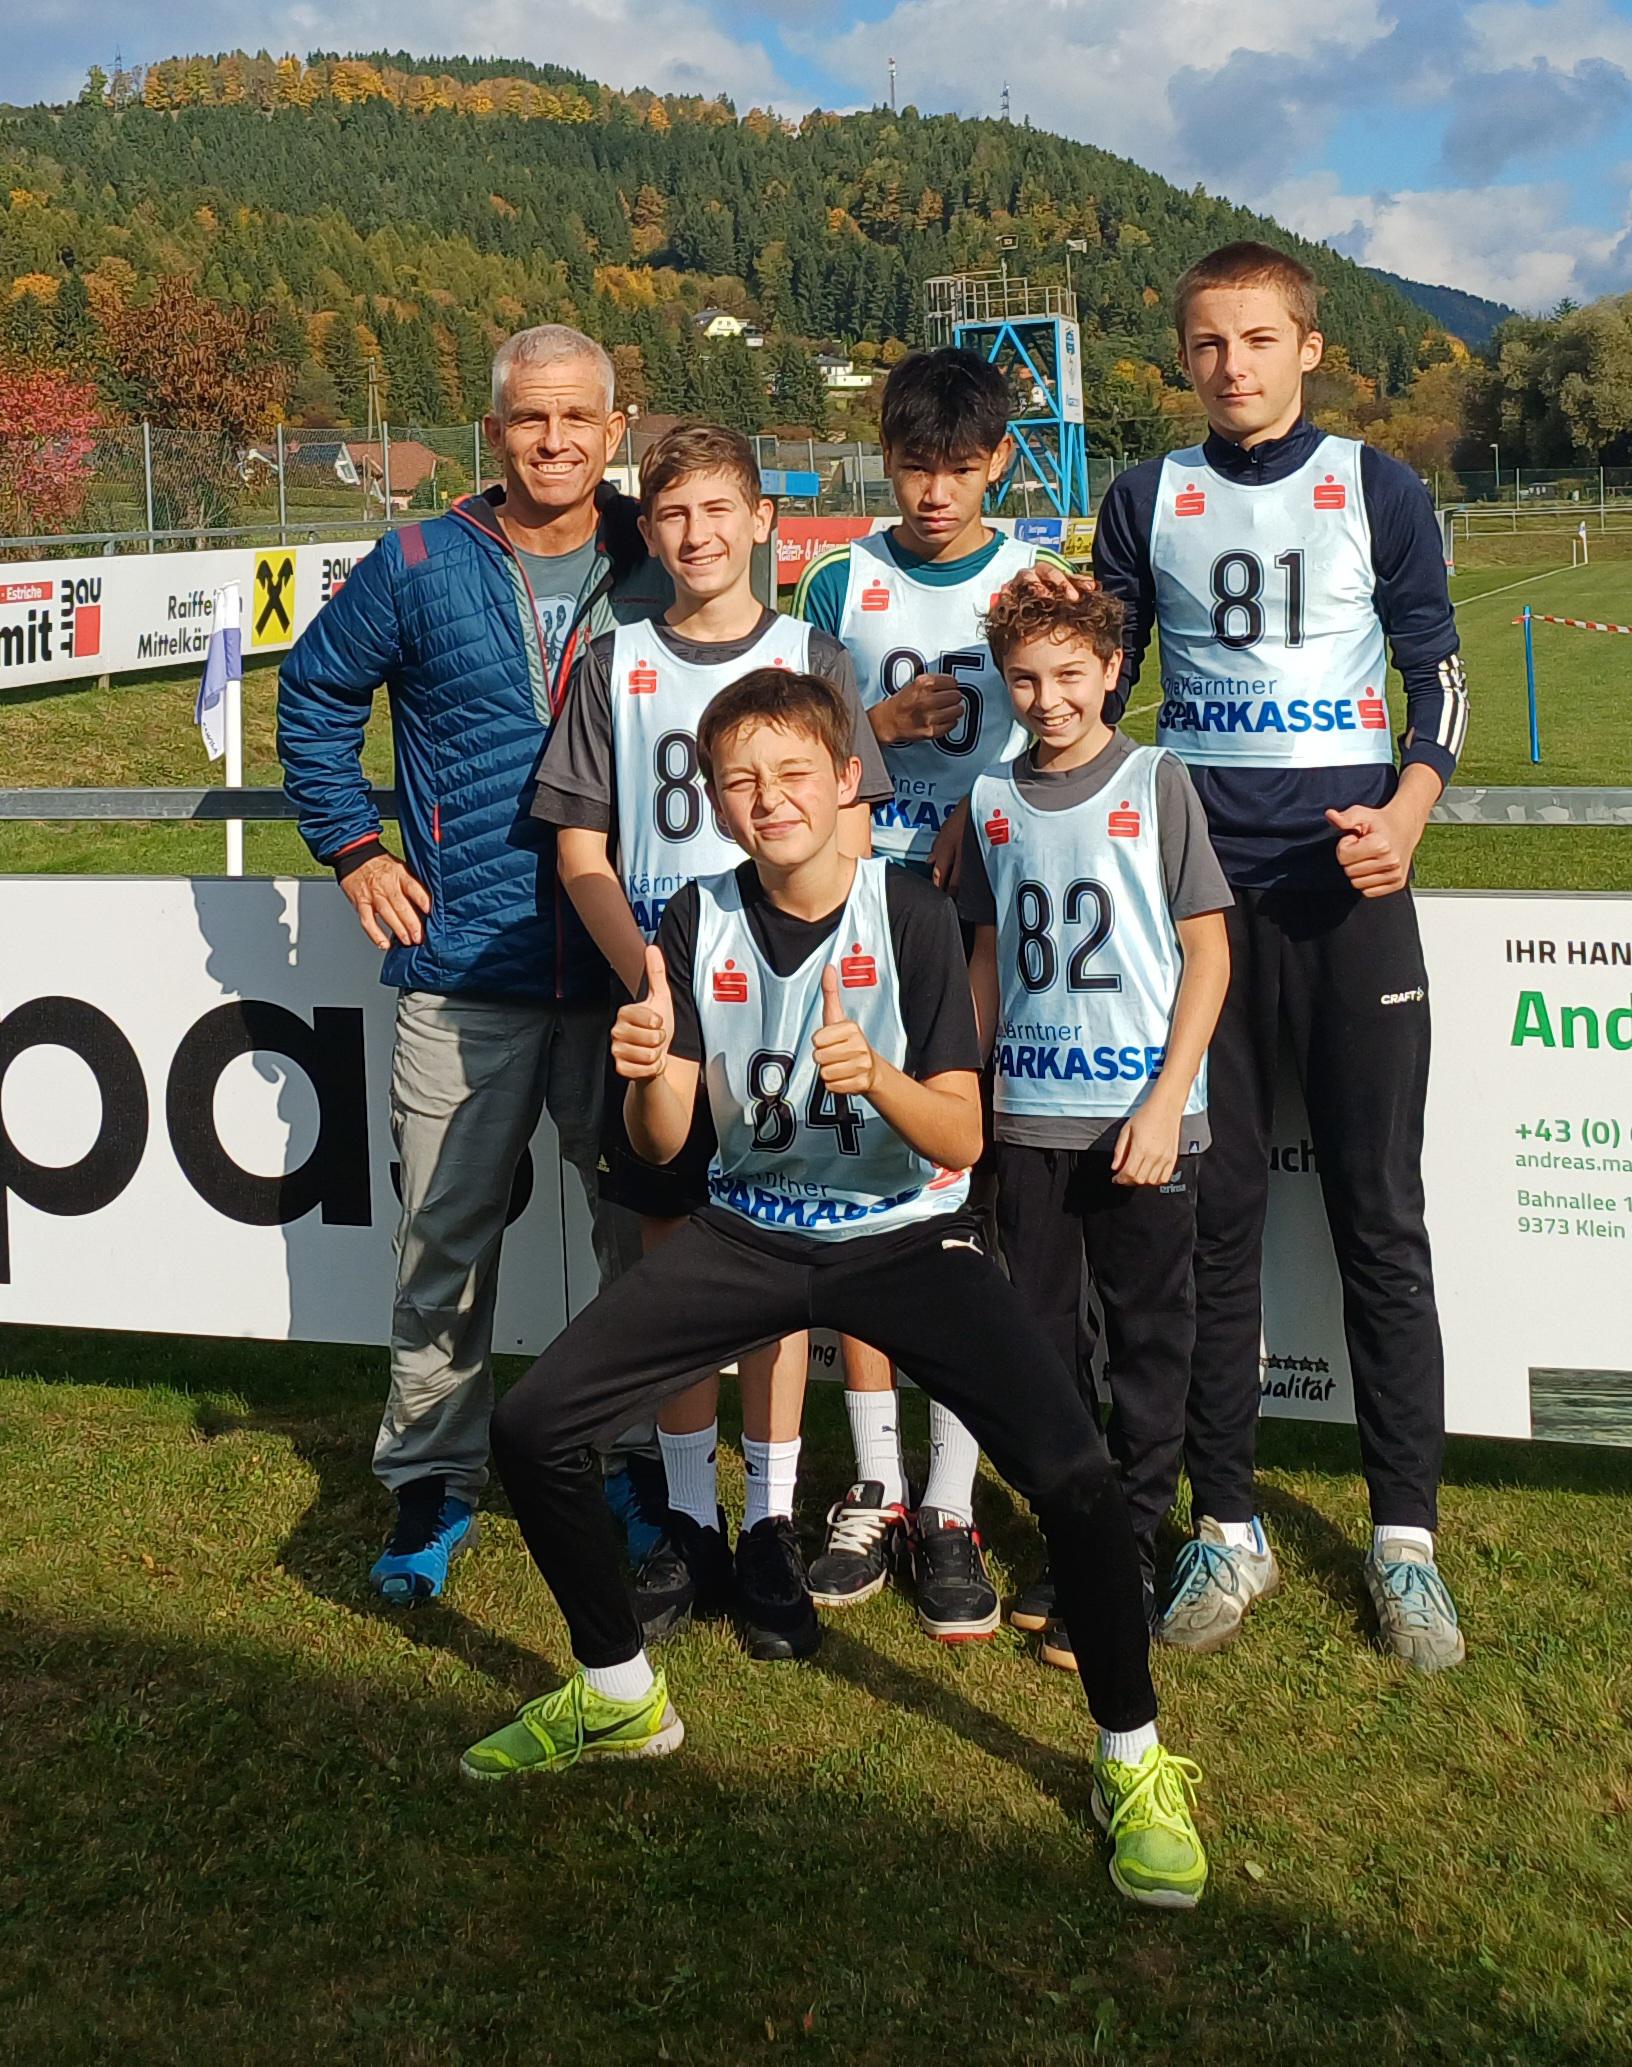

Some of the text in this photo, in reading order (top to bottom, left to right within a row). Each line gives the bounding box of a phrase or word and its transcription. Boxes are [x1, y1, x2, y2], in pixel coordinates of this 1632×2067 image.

[6, 585, 43, 601] Estriche
[168, 589, 243, 621] Raiffei
[1209, 549, 1304, 650] 81
[0, 609, 53, 667] mit
[1159, 699, 1356, 733] SPARKASSE
[629, 872, 697, 897] Kärnt
[1016, 877, 1122, 994] 82
[1506, 940, 1632, 966] IHR HAN
[1380, 990, 1417, 1005] CRAFT
[1510, 990, 1632, 1051] And
[746, 1048, 865, 1156] 84
[1515, 1118, 1621, 1149] +43 (0)
[1515, 1151, 1632, 1173] andreas.ma
[1517, 1189, 1617, 1212] Bahnallee
[1518, 1217, 1626, 1239] 9373 Klein
